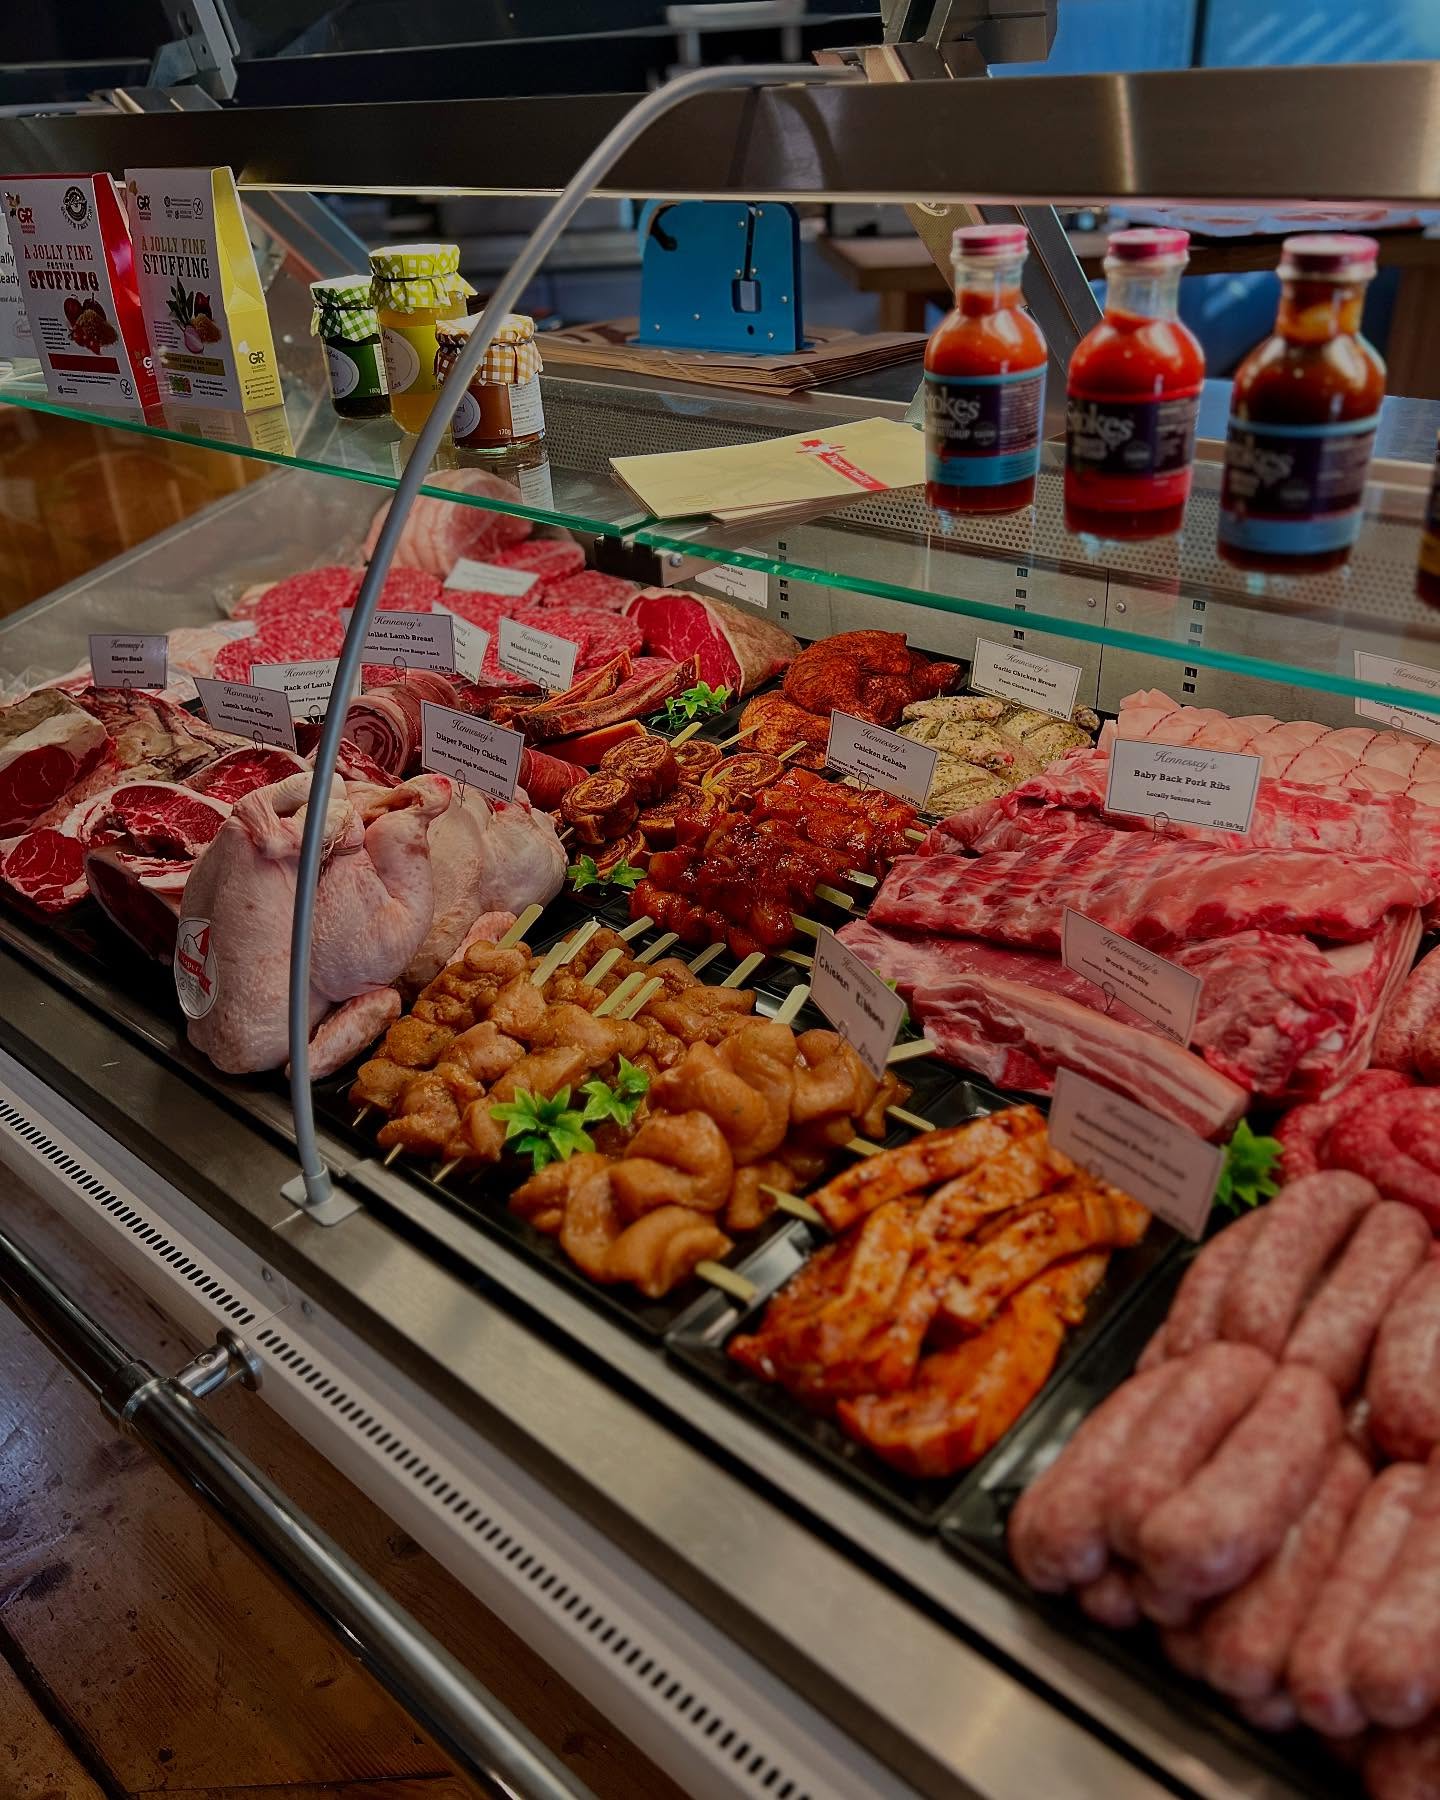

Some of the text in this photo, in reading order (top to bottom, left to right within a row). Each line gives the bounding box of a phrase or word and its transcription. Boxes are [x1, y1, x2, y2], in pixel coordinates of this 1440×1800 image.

[137, 195, 150, 210] GR
[18, 208, 34, 223] GR
[24, 245, 93, 261] A JOLLY FINE
[142, 236, 206, 255] A JOLLY FINE
[47, 262, 75, 270] FESTIVE
[143, 253, 210, 279] STUFFING
[28, 270, 100, 292] STUFFING
[249, 351, 265, 364] GR
[412, 634, 434, 643] Breast
[284, 681, 332, 691] Rack of Lamb
[1013, 670, 1037, 682] Chicken
[1038, 677, 1058, 688] Breast
[222, 700, 240, 710] Lamb
[451, 719, 497, 743] Hennessey's
[861, 728, 906, 753] Hennessey's
[458, 740, 481, 755] Poultry
[481, 750, 508, 766] Chicken
[853, 742, 907, 770] Chicken Kebabs
[1153, 750, 1219, 772] Hennessey's
[1133, 769, 1231, 791] Baby Back Pork Ribs
[1146, 790, 1212, 806] Locally Sourced Pork
[1105, 956, 1127, 972] Pork
[819, 955, 850, 992] Chicken
